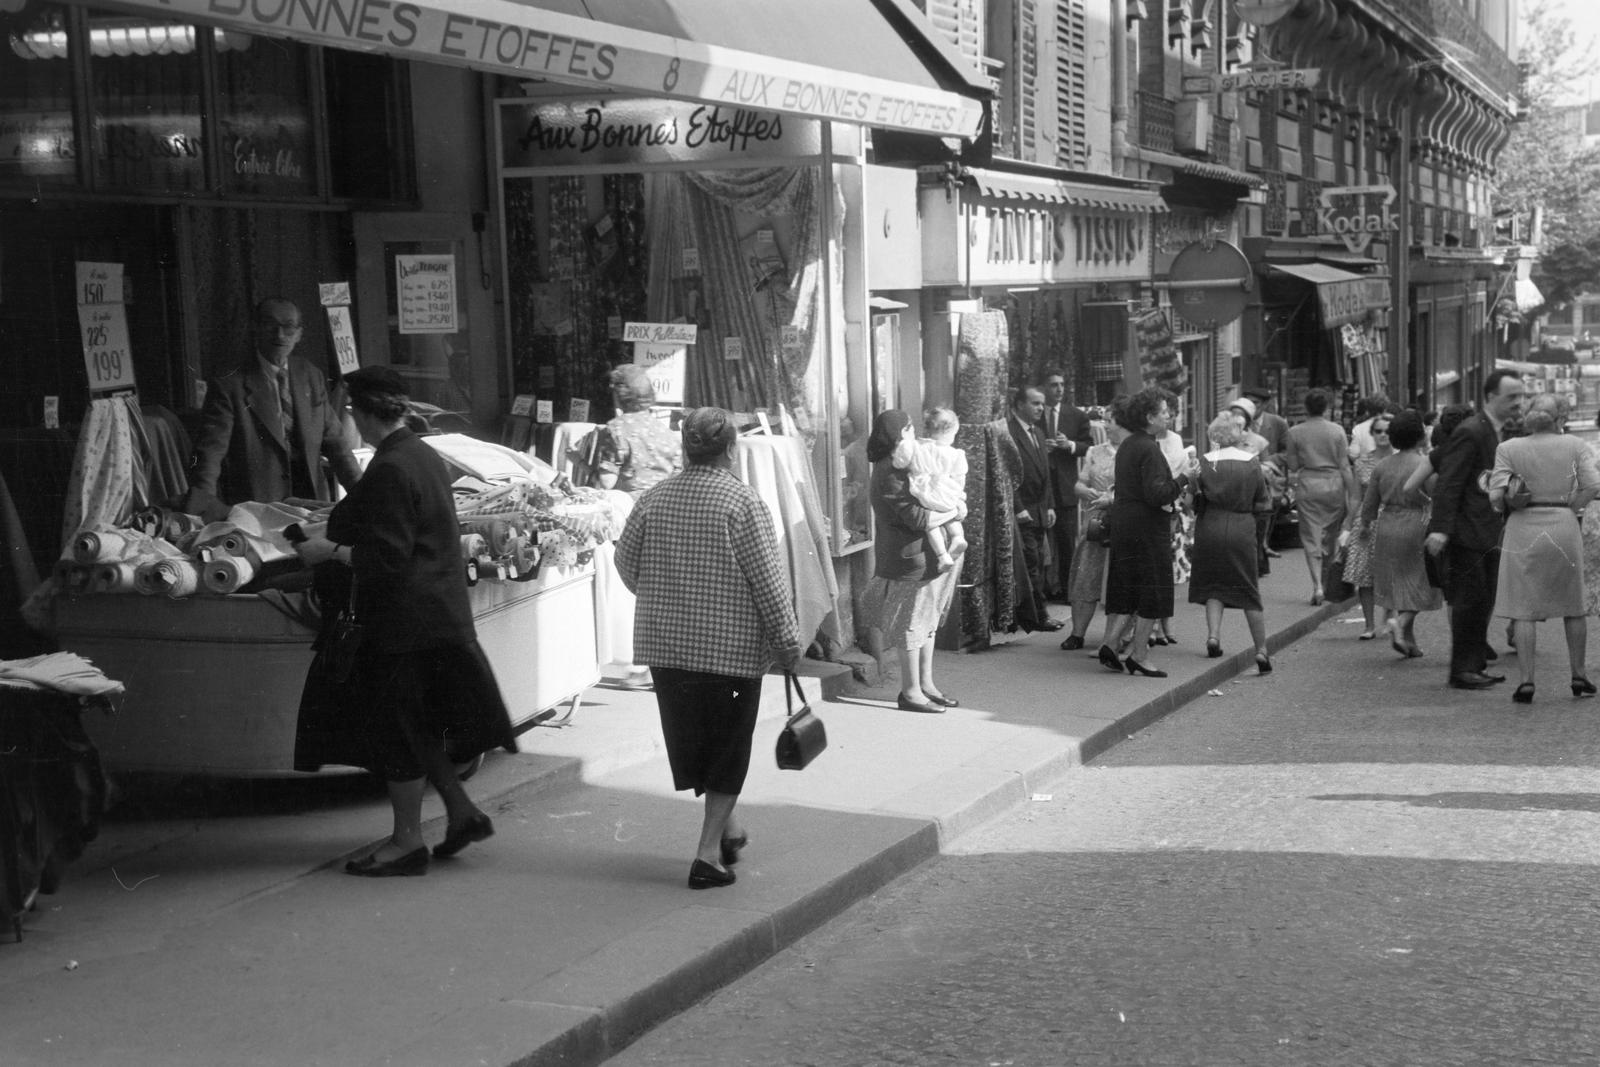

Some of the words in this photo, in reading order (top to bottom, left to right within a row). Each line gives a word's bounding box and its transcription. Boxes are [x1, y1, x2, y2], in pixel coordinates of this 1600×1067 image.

[441, 13, 619, 81] ETOFFES
[662, 57, 681, 92] 8
[720, 69, 775, 106] AUX
[782, 79, 871, 120] BONNES
[875, 96, 957, 133] ETOFFES
[518, 115, 577, 150] Aux
[580, 107, 679, 153] Bonnes
[685, 106, 783, 152] Etoffes
[1071, 214, 1136, 267] TISSUS
[1317, 206, 1400, 233] Kodak
[626, 325, 651, 340] PRIX
